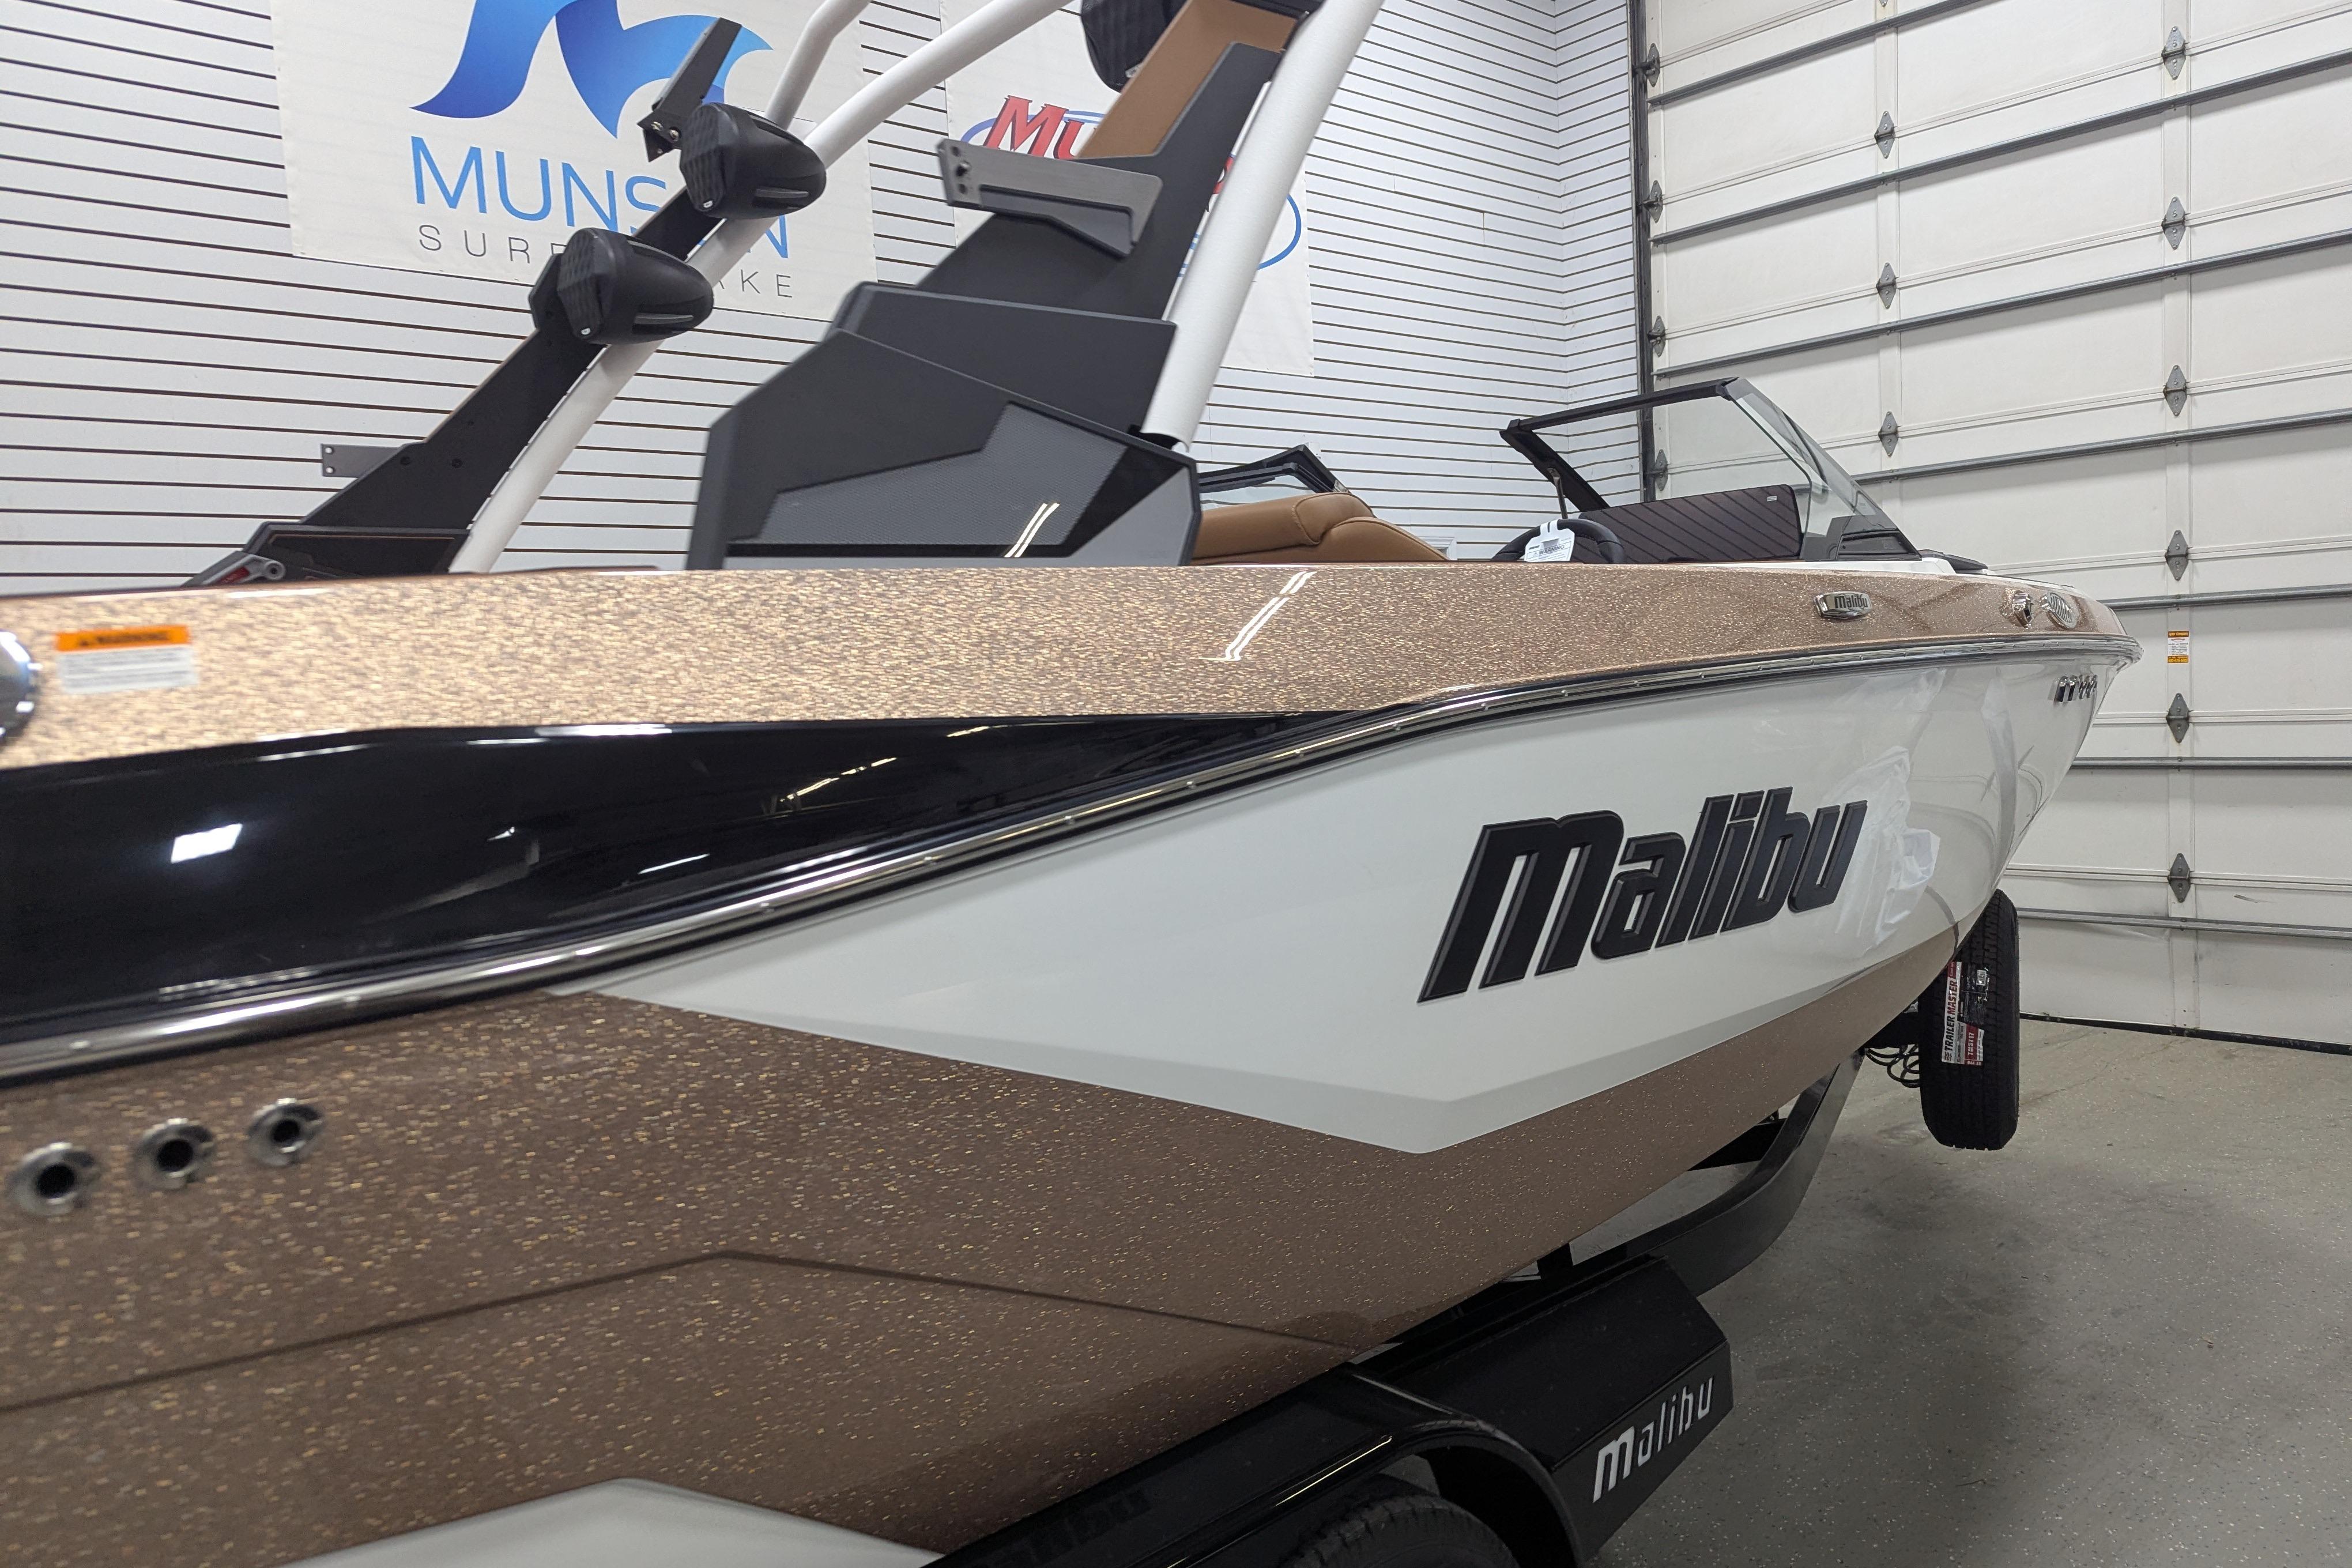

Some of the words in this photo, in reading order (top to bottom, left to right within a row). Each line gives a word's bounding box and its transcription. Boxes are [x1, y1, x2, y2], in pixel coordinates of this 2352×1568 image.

[410, 135, 789, 259] MUNSN
[1416, 786, 1868, 1004] Malibu
[1944, 1015, 1955, 1051] TRAILER
[1947, 980, 1958, 1015] MASTER
[1592, 1377, 1713, 1503] Malibu
